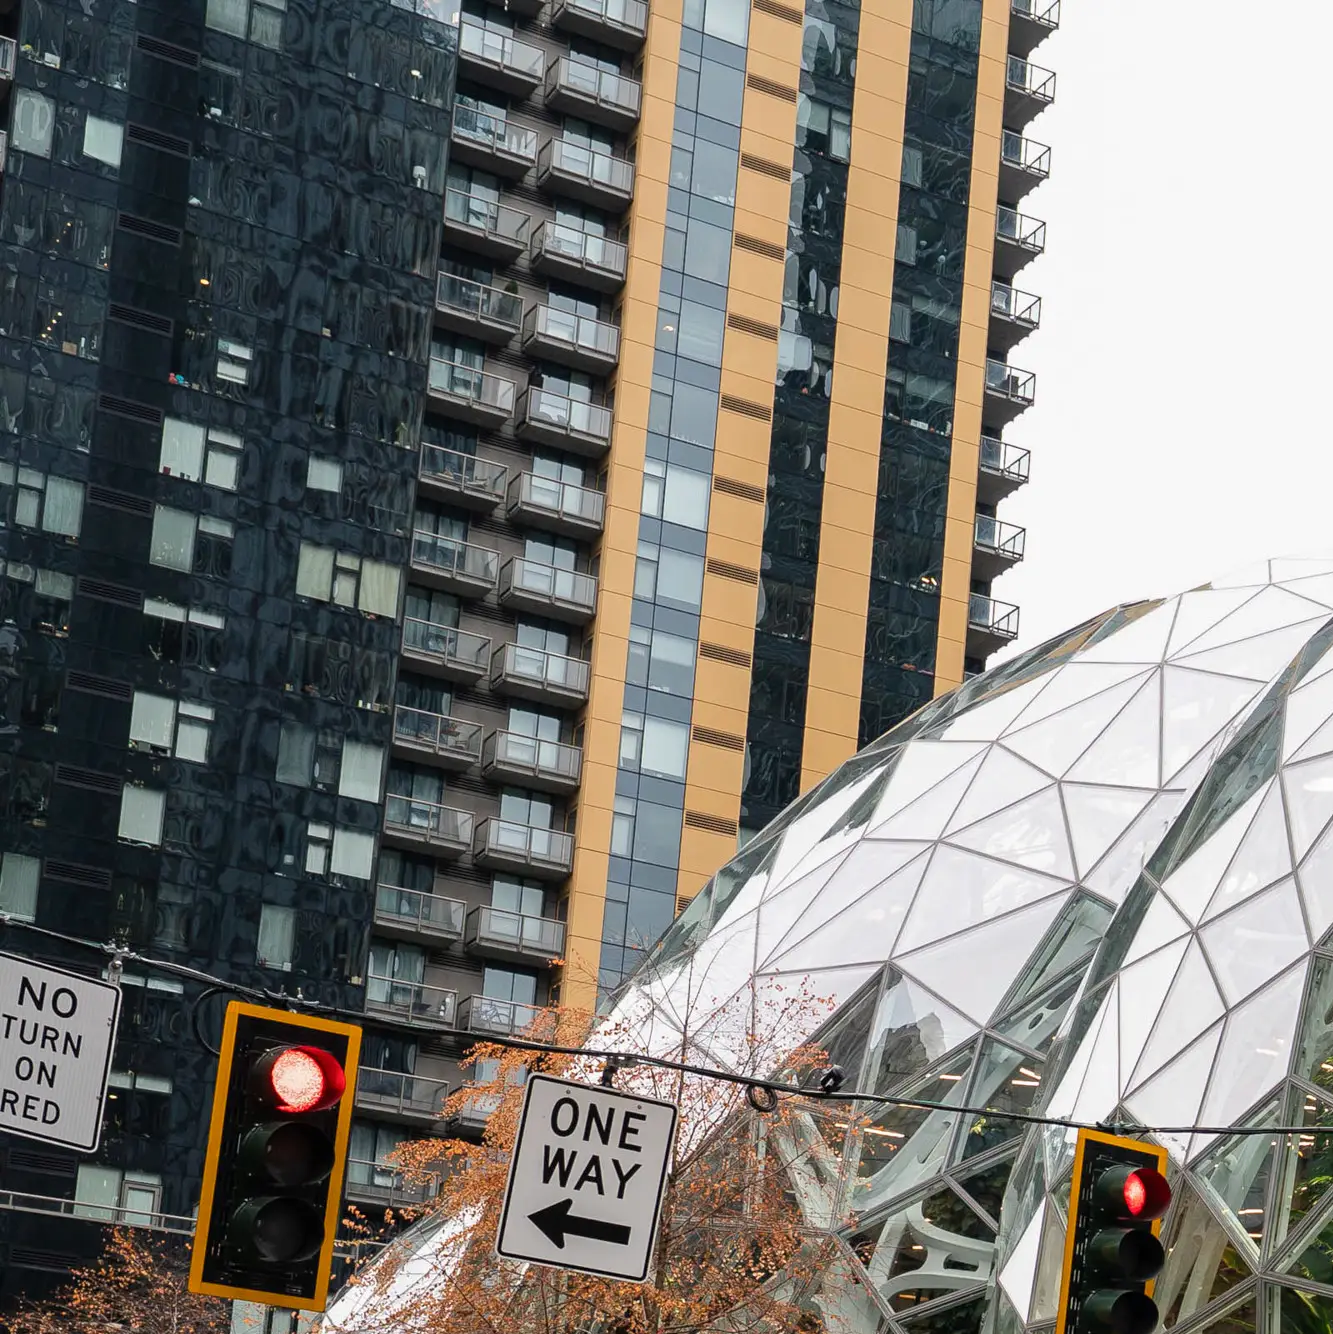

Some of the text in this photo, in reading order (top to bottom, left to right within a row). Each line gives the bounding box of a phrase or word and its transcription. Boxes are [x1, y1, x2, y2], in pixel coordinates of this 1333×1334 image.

[17, 976, 78, 1019] NO
[2, 1013, 83, 1059] TURN
[15, 1056, 57, 1089] ON
[0, 1088, 61, 1125] RED
[550, 1097, 648, 1153] ONE
[542, 1144, 643, 1200] WAY
